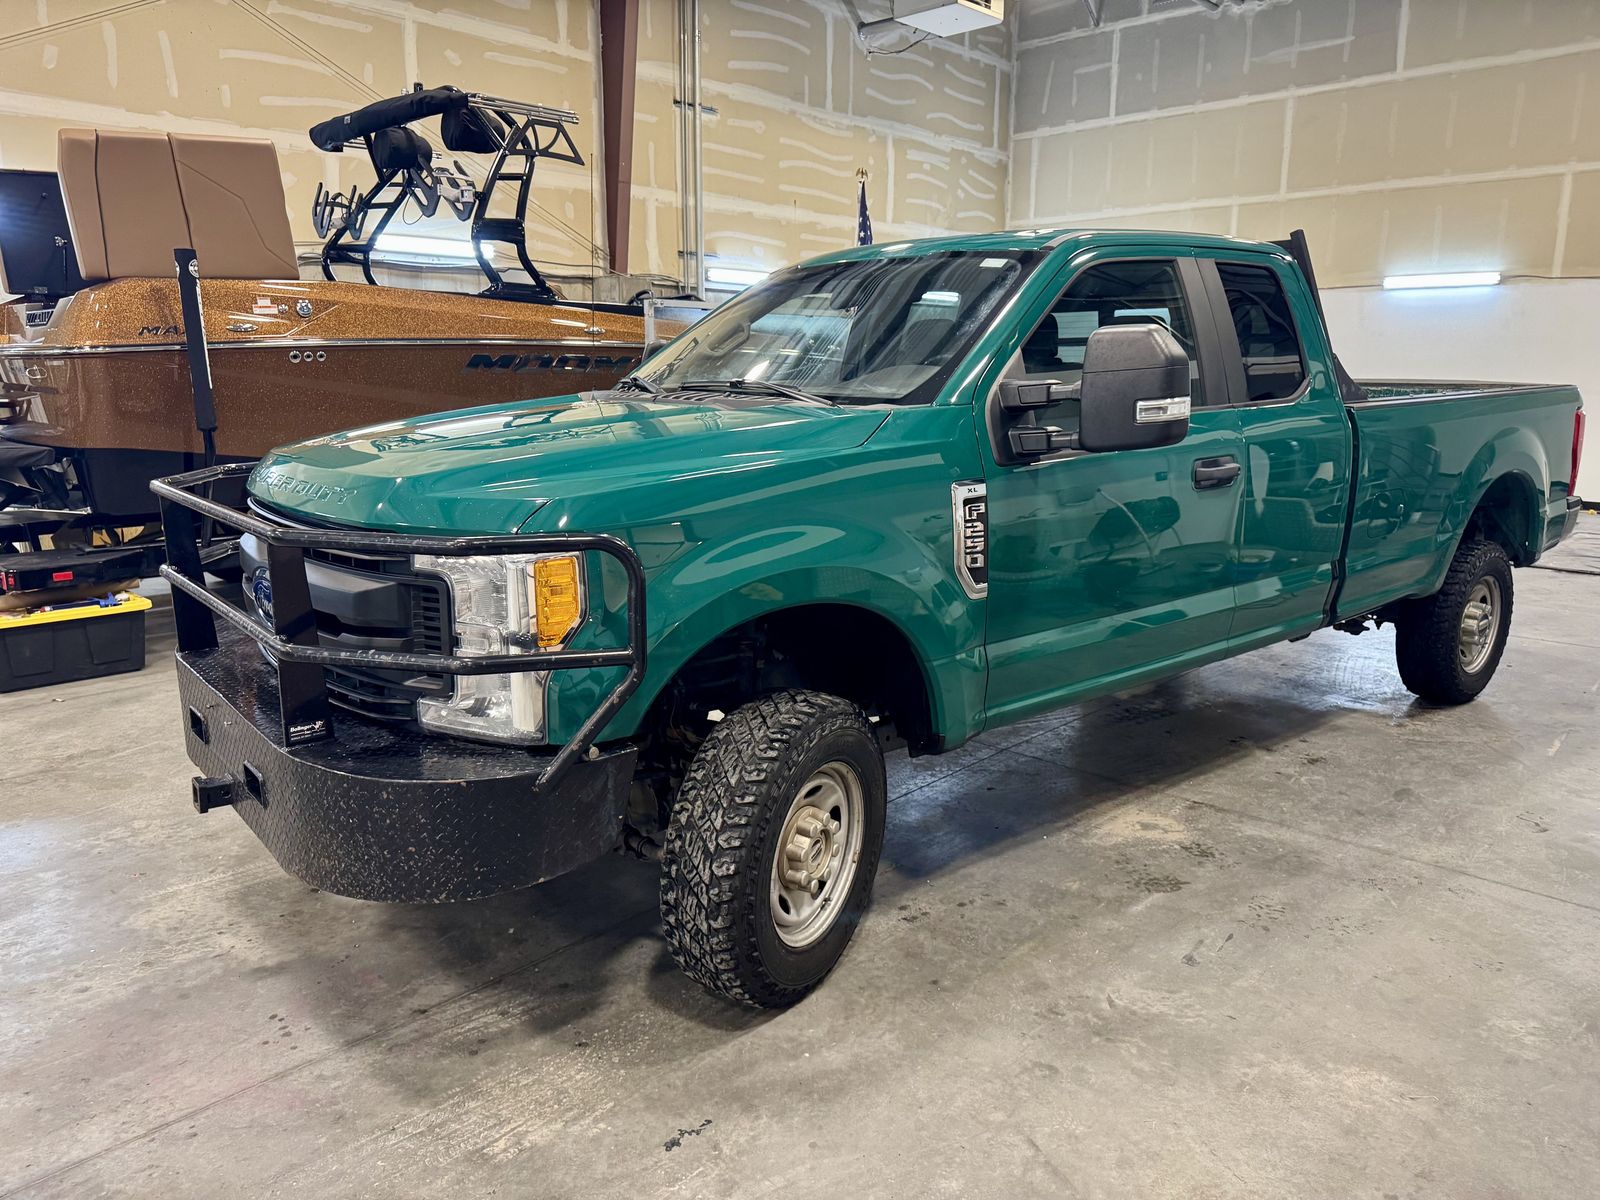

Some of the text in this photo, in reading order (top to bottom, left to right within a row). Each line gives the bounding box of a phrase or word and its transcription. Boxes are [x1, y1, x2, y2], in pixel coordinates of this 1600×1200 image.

[138, 325, 185, 336] MA
[463, 353, 640, 373] MOOM
[292, 481, 357, 505] DUTY
[964, 502, 985, 569] F250
